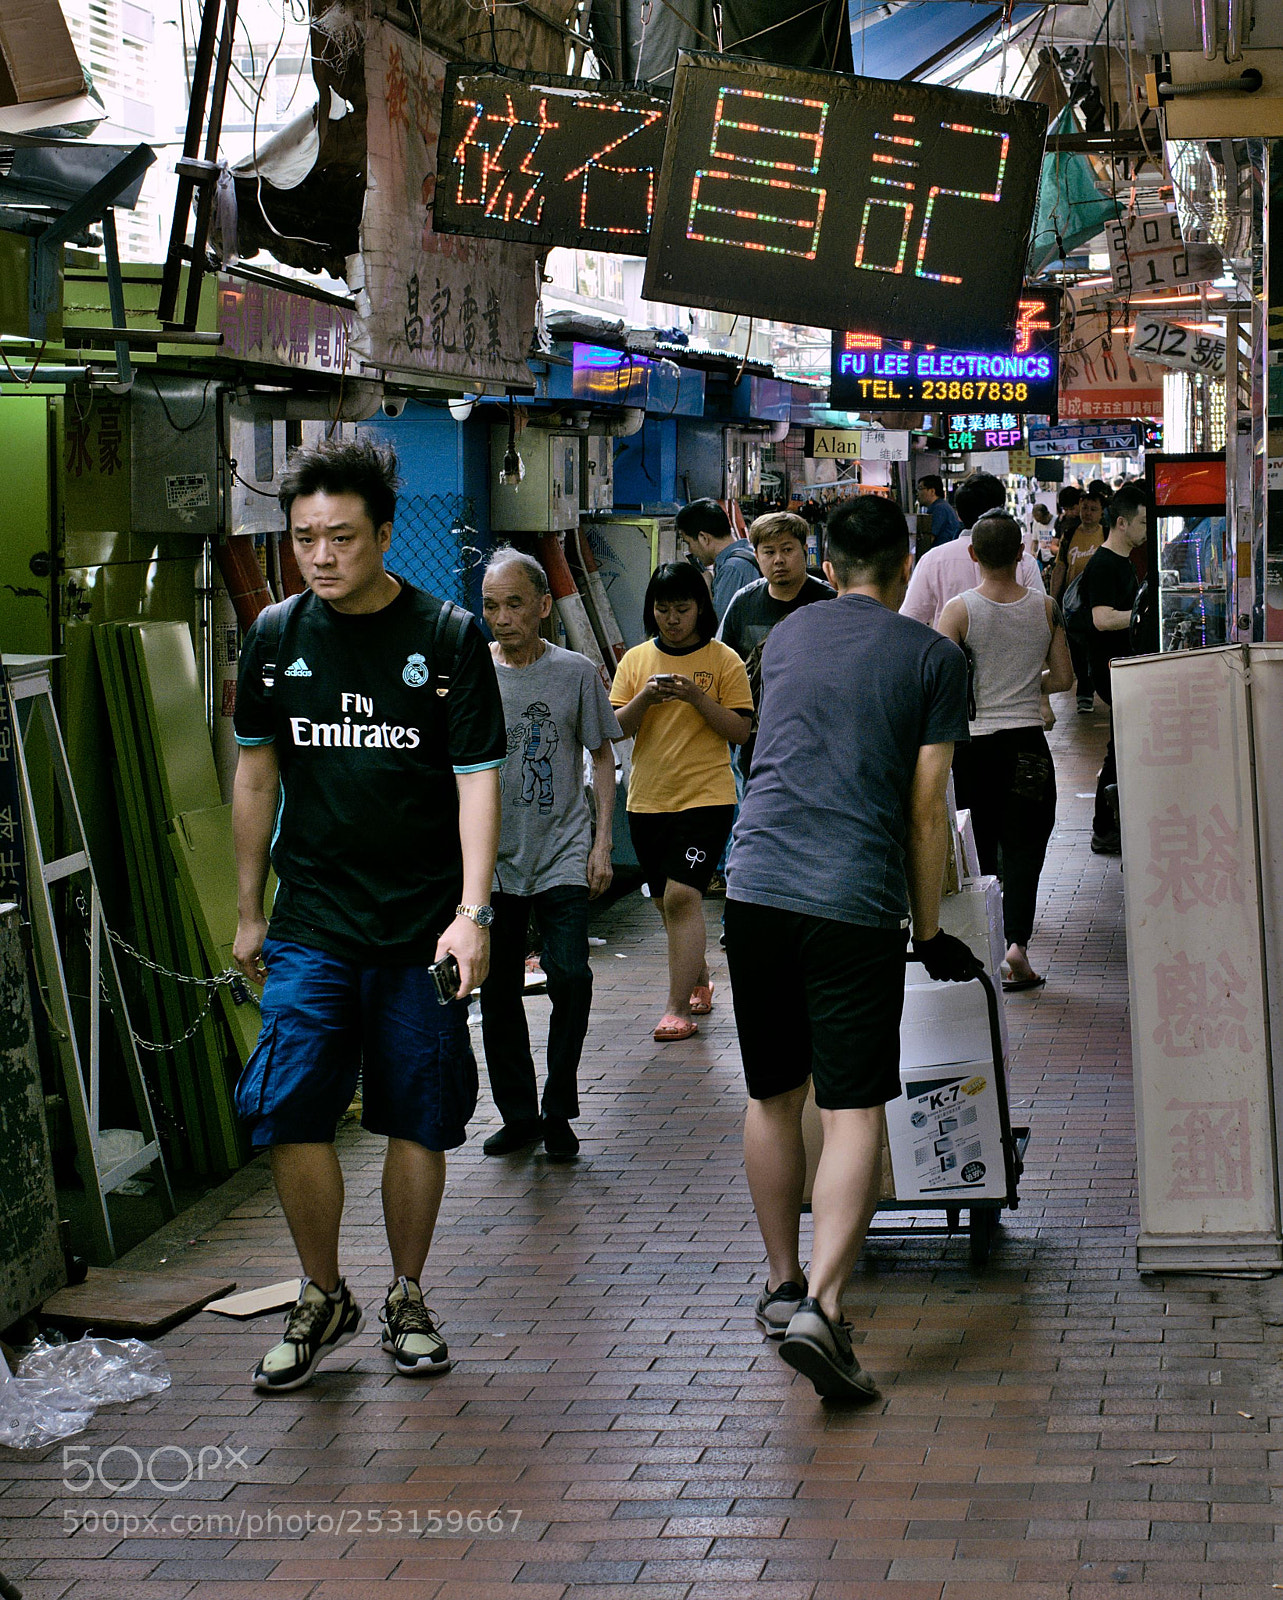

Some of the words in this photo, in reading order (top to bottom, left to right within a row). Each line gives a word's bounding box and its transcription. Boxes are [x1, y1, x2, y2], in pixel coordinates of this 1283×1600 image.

[686, 85, 1010, 285] 昌記
[840, 354, 866, 375] FU
[874, 354, 909, 376] LEE
[917, 354, 1050, 378] ELECTRONICS
[922, 382, 1028, 402] 23867838
[951, 413, 1018, 432] 專業維修
[815, 436, 857, 454] Alan
[864, 431, 886, 444] 手機
[985, 431, 1021, 448] REP
[1079, 436, 1133, 451] CCTV
[284, 669, 313, 677] adidas
[341, 692, 374, 718] Fly
[289, 716, 421, 750] Emirates
[930, 1085, 961, 1111] K-7
